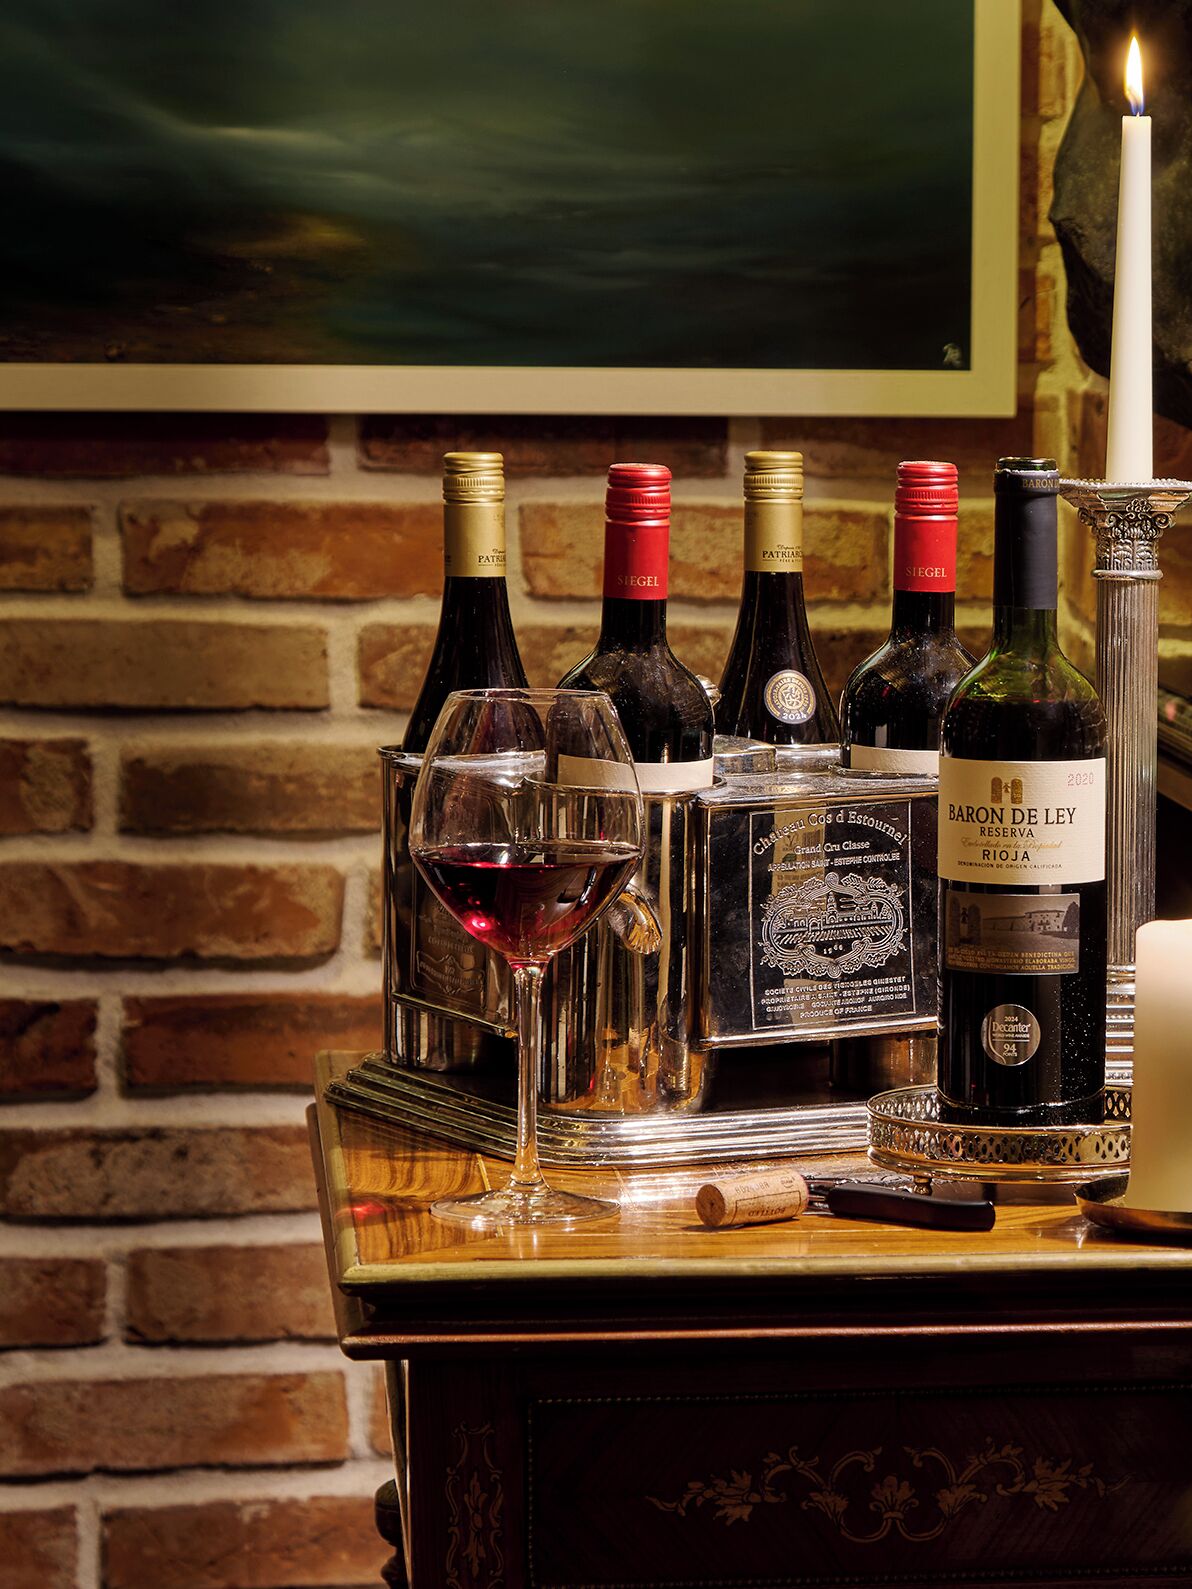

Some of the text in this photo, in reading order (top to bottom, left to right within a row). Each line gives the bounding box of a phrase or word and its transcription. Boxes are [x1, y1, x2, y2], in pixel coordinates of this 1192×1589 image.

[905, 566, 947, 578] SIEGEL
[617, 574, 659, 586] SIEGEL
[782, 711, 807, 720] 2024
[1067, 772, 1094, 786] 2020
[949, 804, 1077, 825] BARON DE LEY
[808, 814, 832, 826] Cos
[848, 810, 908, 846] Estournel
[980, 827, 1034, 838] RESERVA
[794, 840, 870, 855] Grand Cru Classe
[982, 849, 1030, 861] RIOJA
[992, 1022, 1031, 1033] Decanter
[1003, 1043, 1017, 1053] 94
